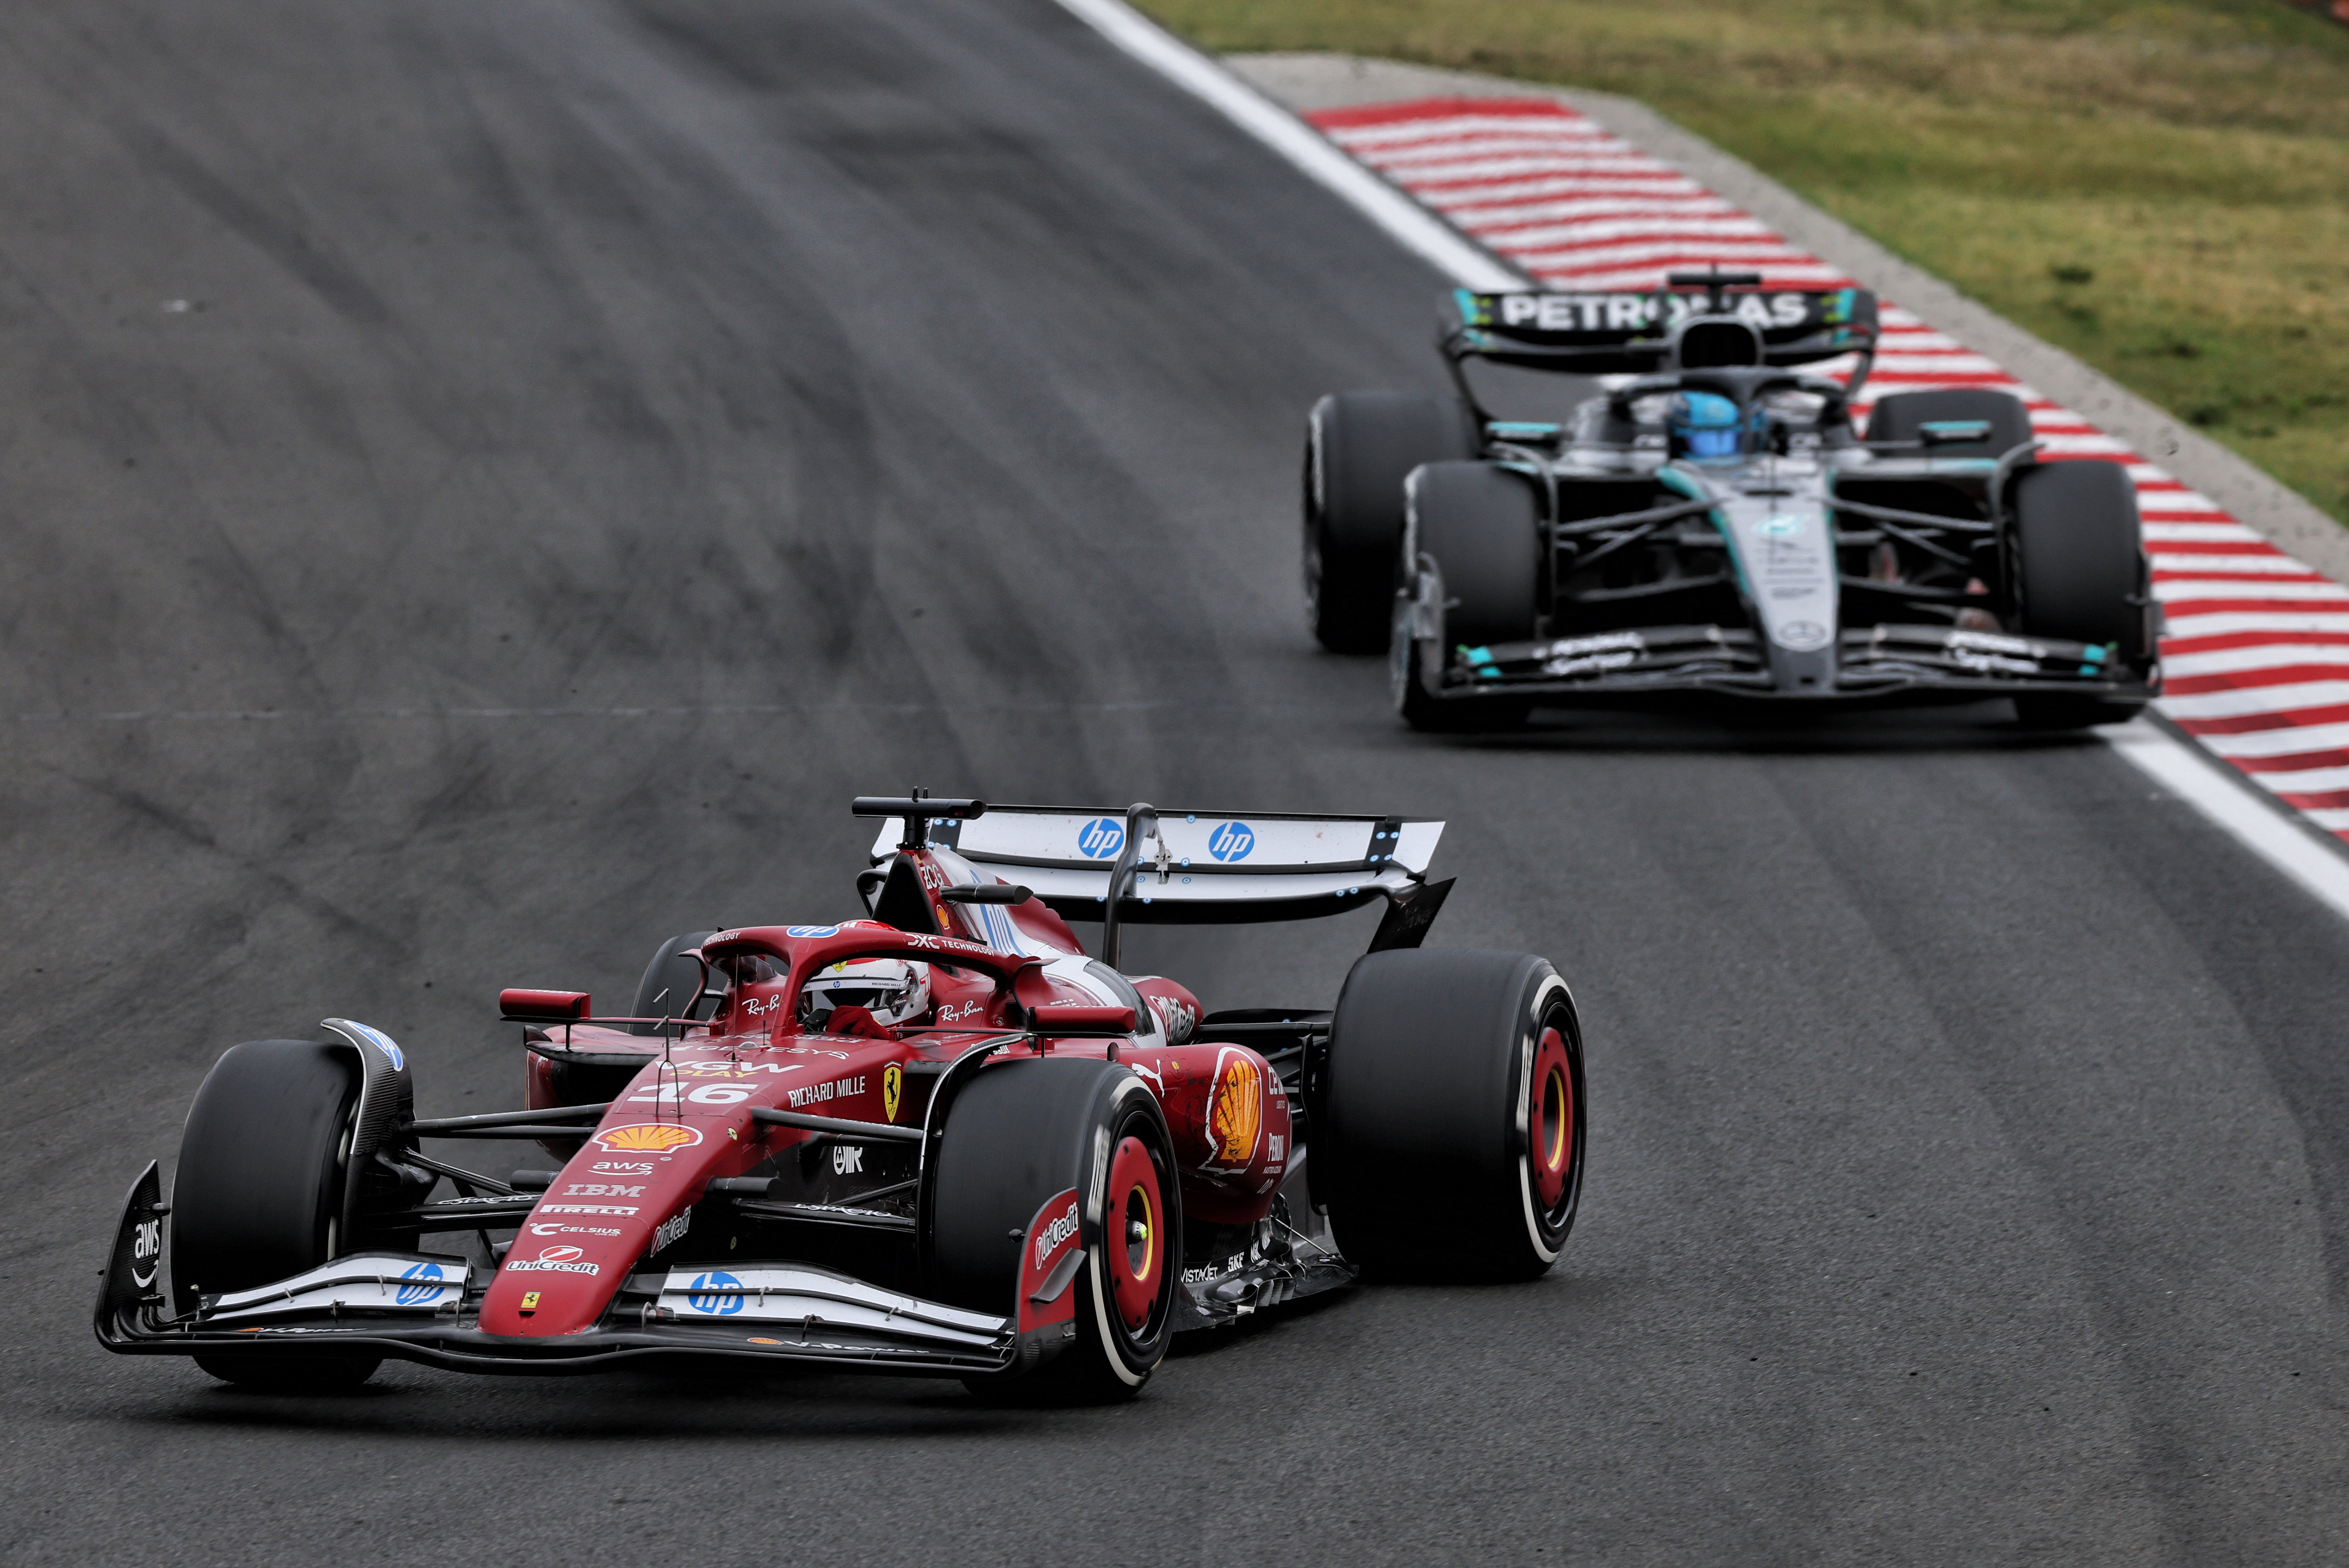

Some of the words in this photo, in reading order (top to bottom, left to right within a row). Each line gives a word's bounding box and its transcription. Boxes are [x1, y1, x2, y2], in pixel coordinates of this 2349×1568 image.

[1082, 818, 1121, 859] hp
[1212, 821, 1251, 862] hp
[704, 932, 741, 946] TECHNOLOGY
[792, 926, 834, 937] hp
[906, 933, 940, 949] DXC
[941, 940, 994, 957] TECHNOLOGY
[938, 1000, 984, 1022] Ray-Ban
[696, 1046, 849, 1060] GEESYS
[655, 1061, 806, 1073] VGW
[669, 1070, 758, 1078] PLAY
[627, 1082, 758, 1104] 16
[787, 1082, 834, 1108] RICHARD
[836, 1076, 866, 1098] MILLE
[1268, 1133, 1284, 1162] PERONI
[593, 1162, 655, 1170] aws
[562, 1184, 646, 1197] IBM
[539, 1205, 640, 1215] PIRELLI
[794, 1203, 891, 1217] ESPACIO
[135, 1219, 159, 1259] aws
[1042, 1201, 1078, 1261] UniCredit
[1228, 1251, 1244, 1272] SKF
[1250, 1240, 1262, 1263] NGK
[506, 1260, 600, 1276] UniCredit
[399, 1263, 440, 1305] hp
[695, 1272, 740, 1314] hp
[784, 1341, 930, 1353] V-Power
